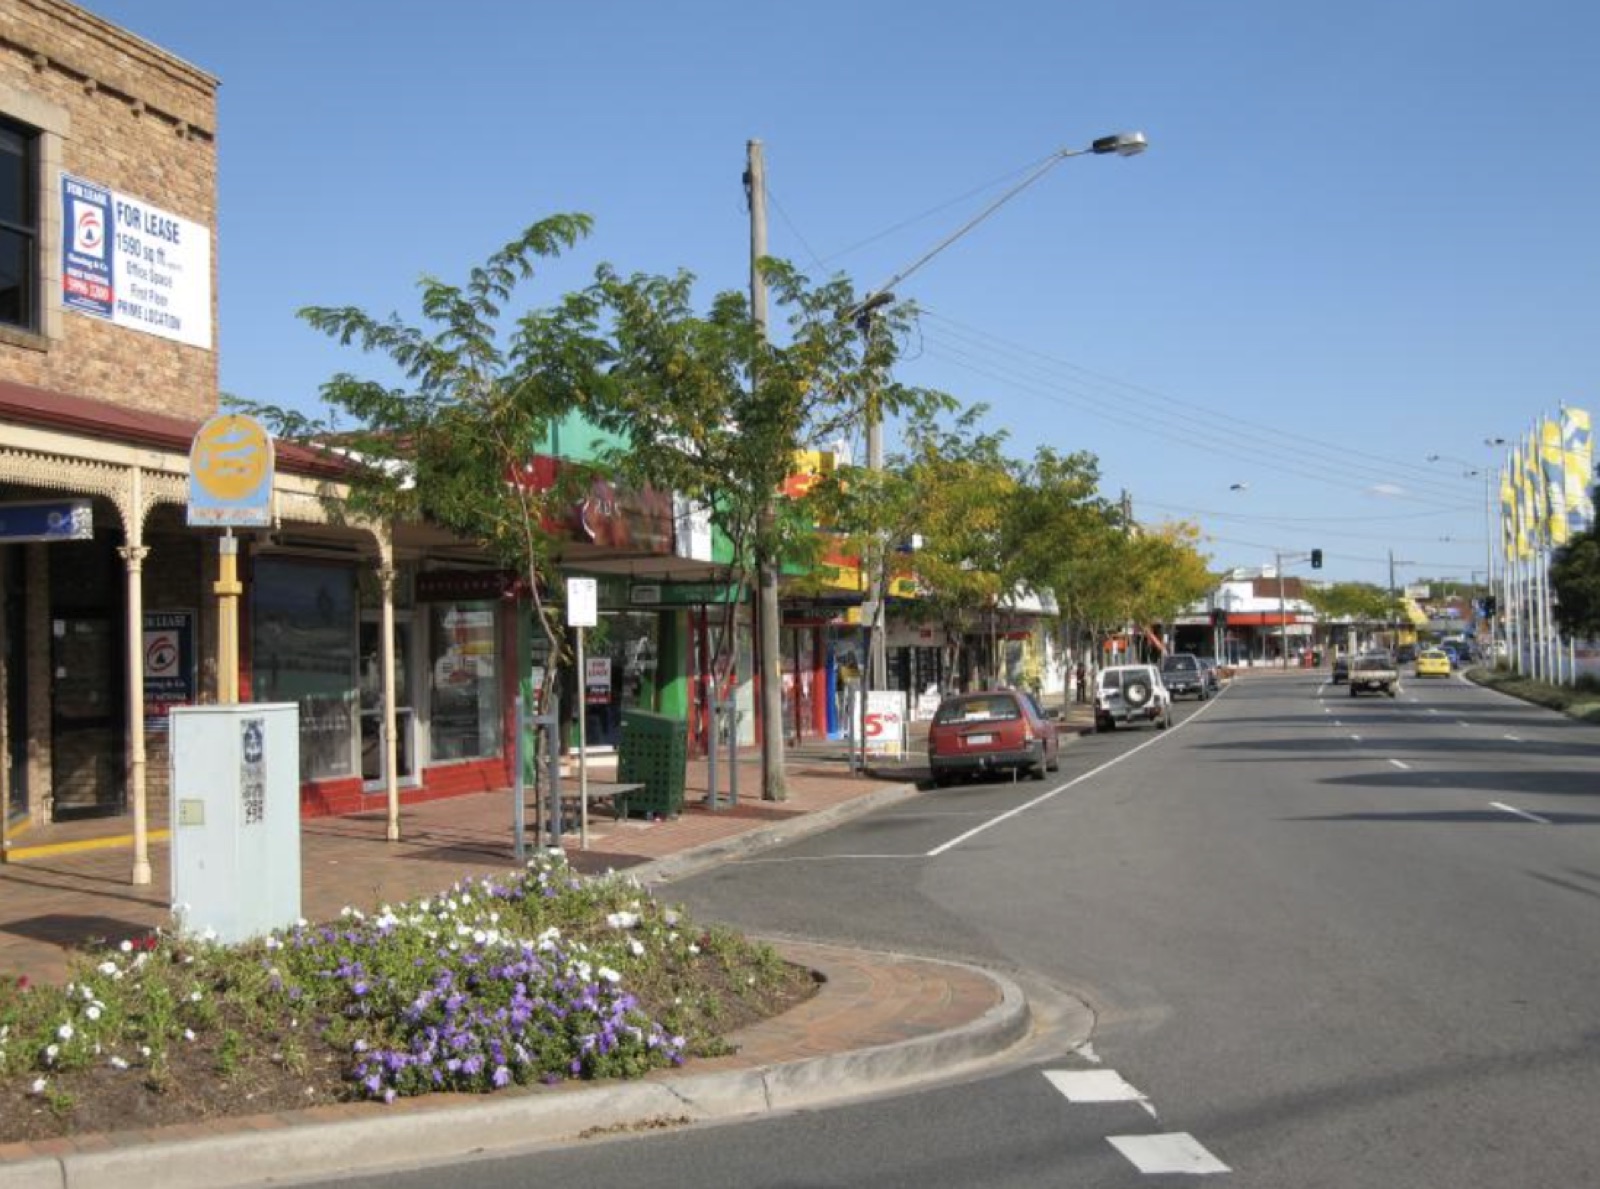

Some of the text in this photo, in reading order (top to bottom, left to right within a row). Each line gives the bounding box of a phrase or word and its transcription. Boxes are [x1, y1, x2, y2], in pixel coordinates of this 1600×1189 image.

[116, 201, 181, 245] FOR LEASE
[117, 299, 142, 319] PRIME
[144, 308, 181, 330] LOCATION
